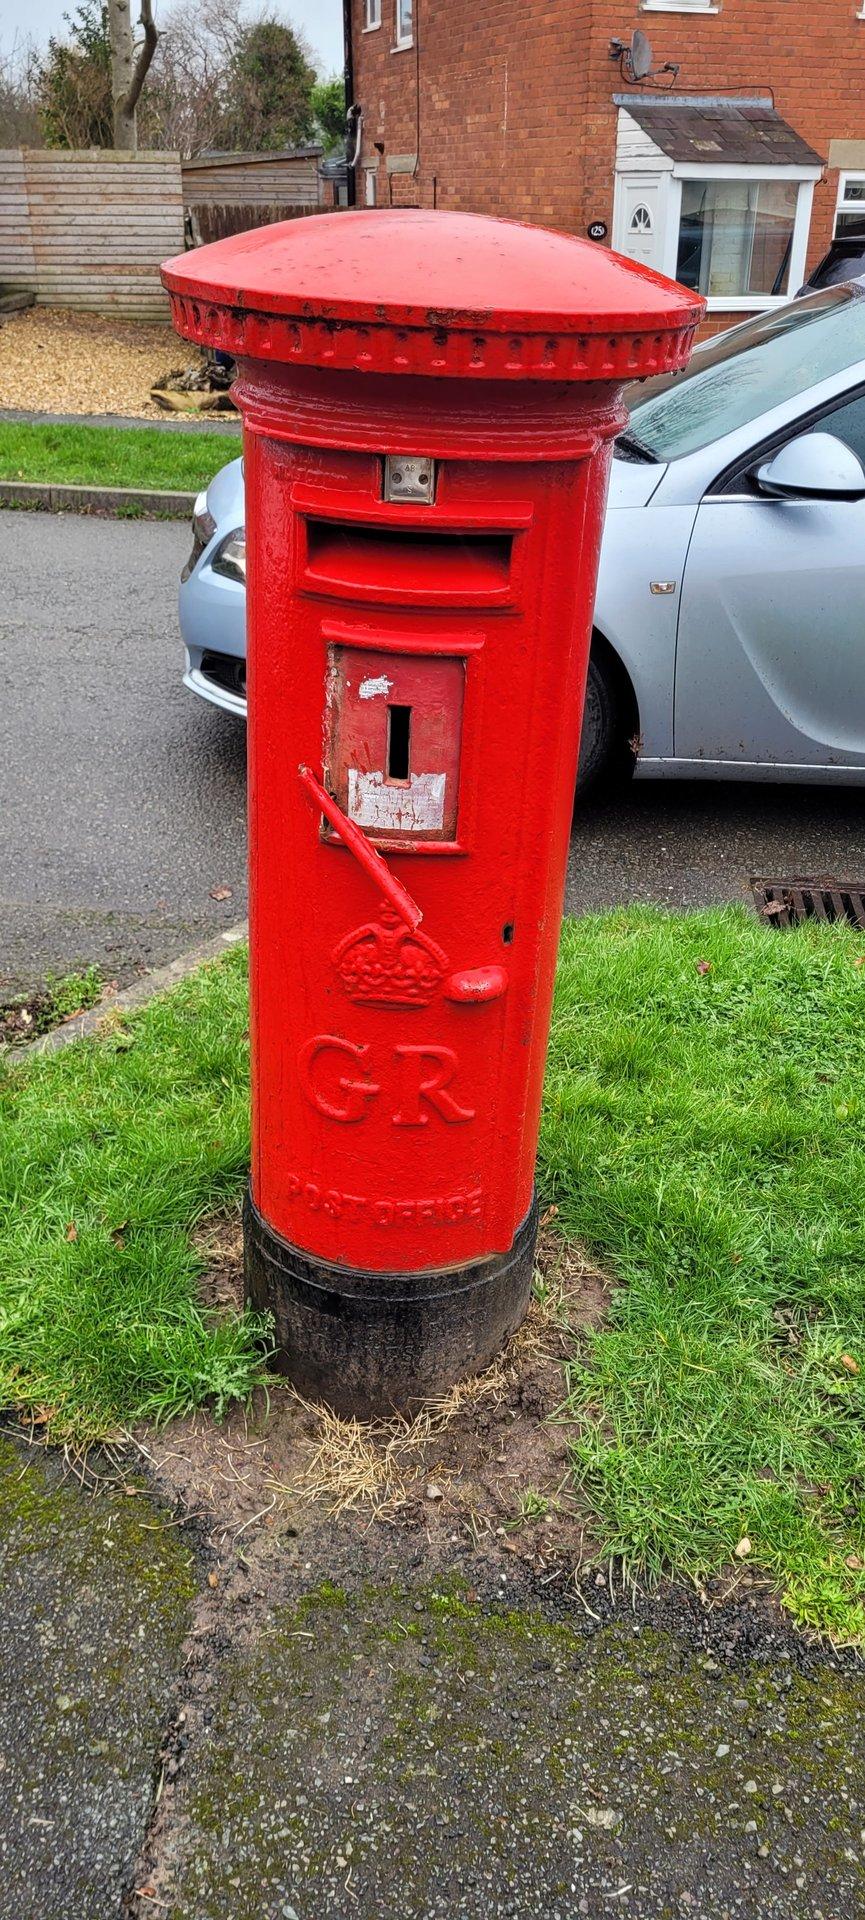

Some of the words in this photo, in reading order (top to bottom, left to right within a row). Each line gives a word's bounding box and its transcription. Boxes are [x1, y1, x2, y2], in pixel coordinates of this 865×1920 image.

[302, 1034, 475, 1127] GR
[287, 1173, 366, 1219] POST
[373, 1187, 482, 1226] OFFICE
